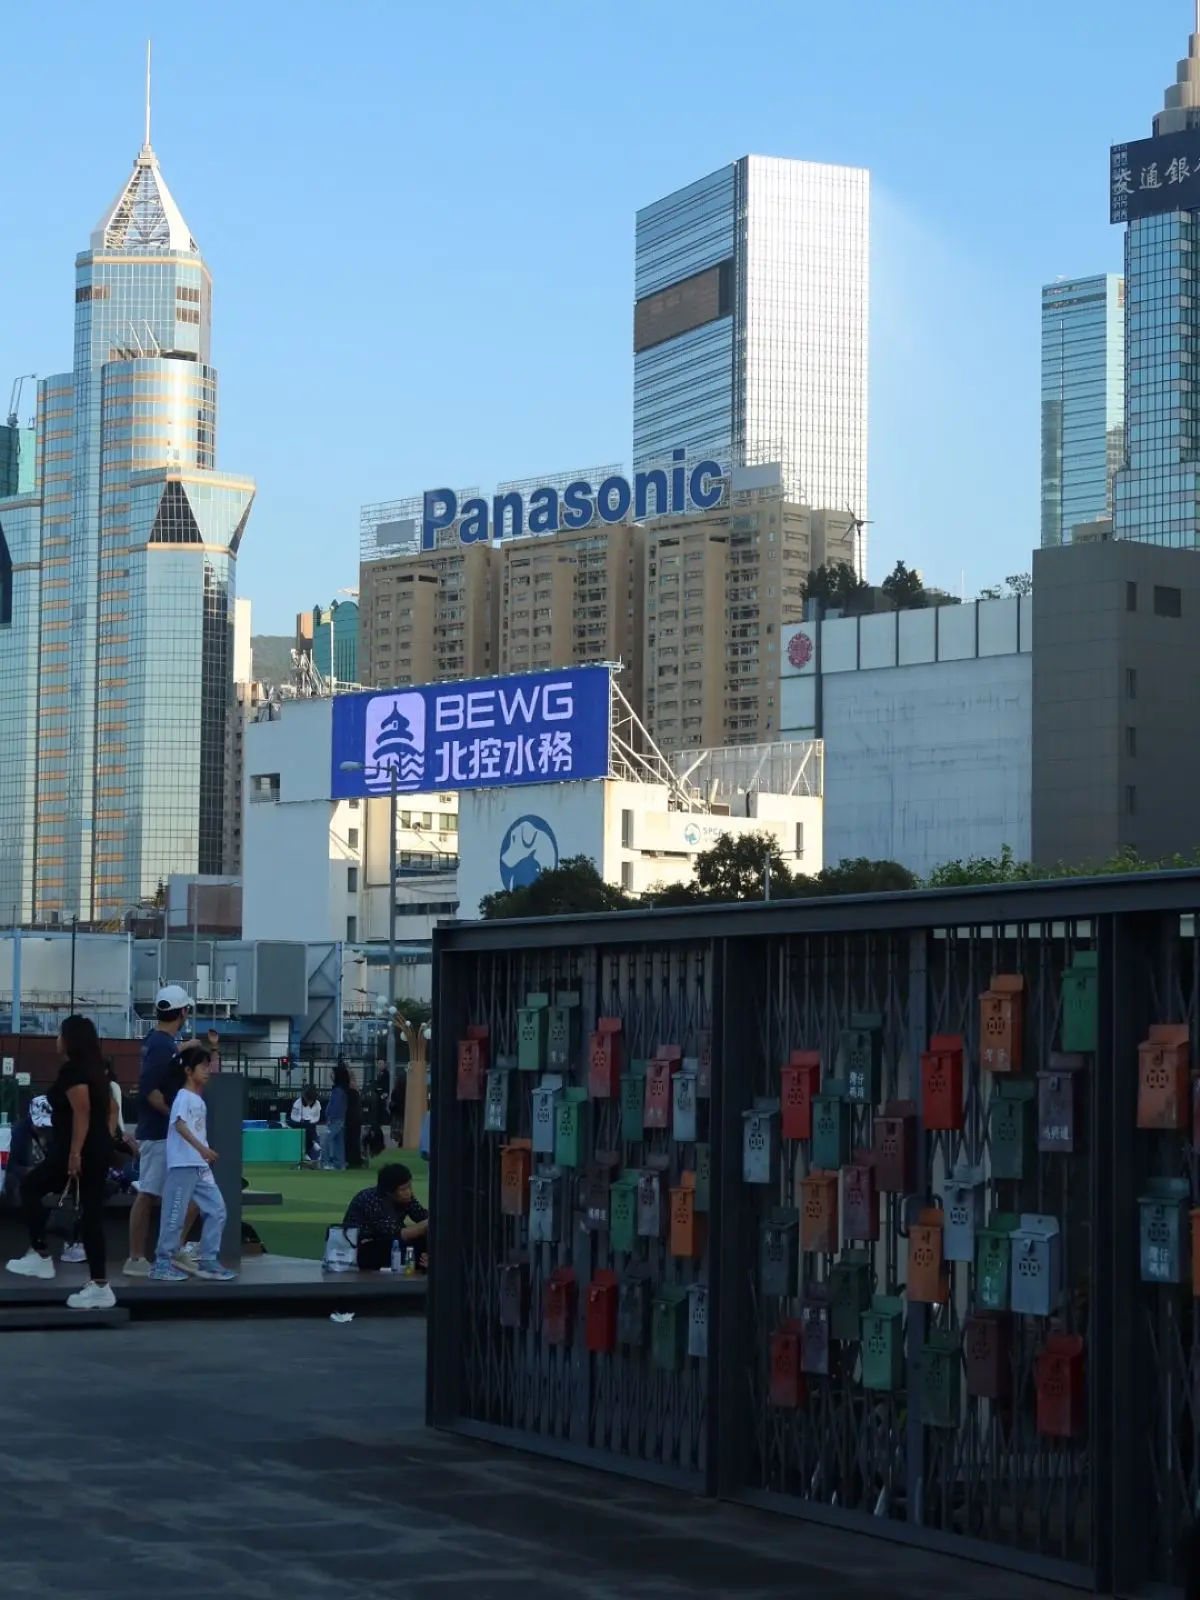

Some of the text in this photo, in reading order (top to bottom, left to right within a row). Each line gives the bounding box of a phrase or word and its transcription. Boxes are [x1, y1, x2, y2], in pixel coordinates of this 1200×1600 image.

[422, 448, 726, 550] Panasonic
[435, 681, 574, 732] BEWG
[434, 731, 573, 782] 北控水務
